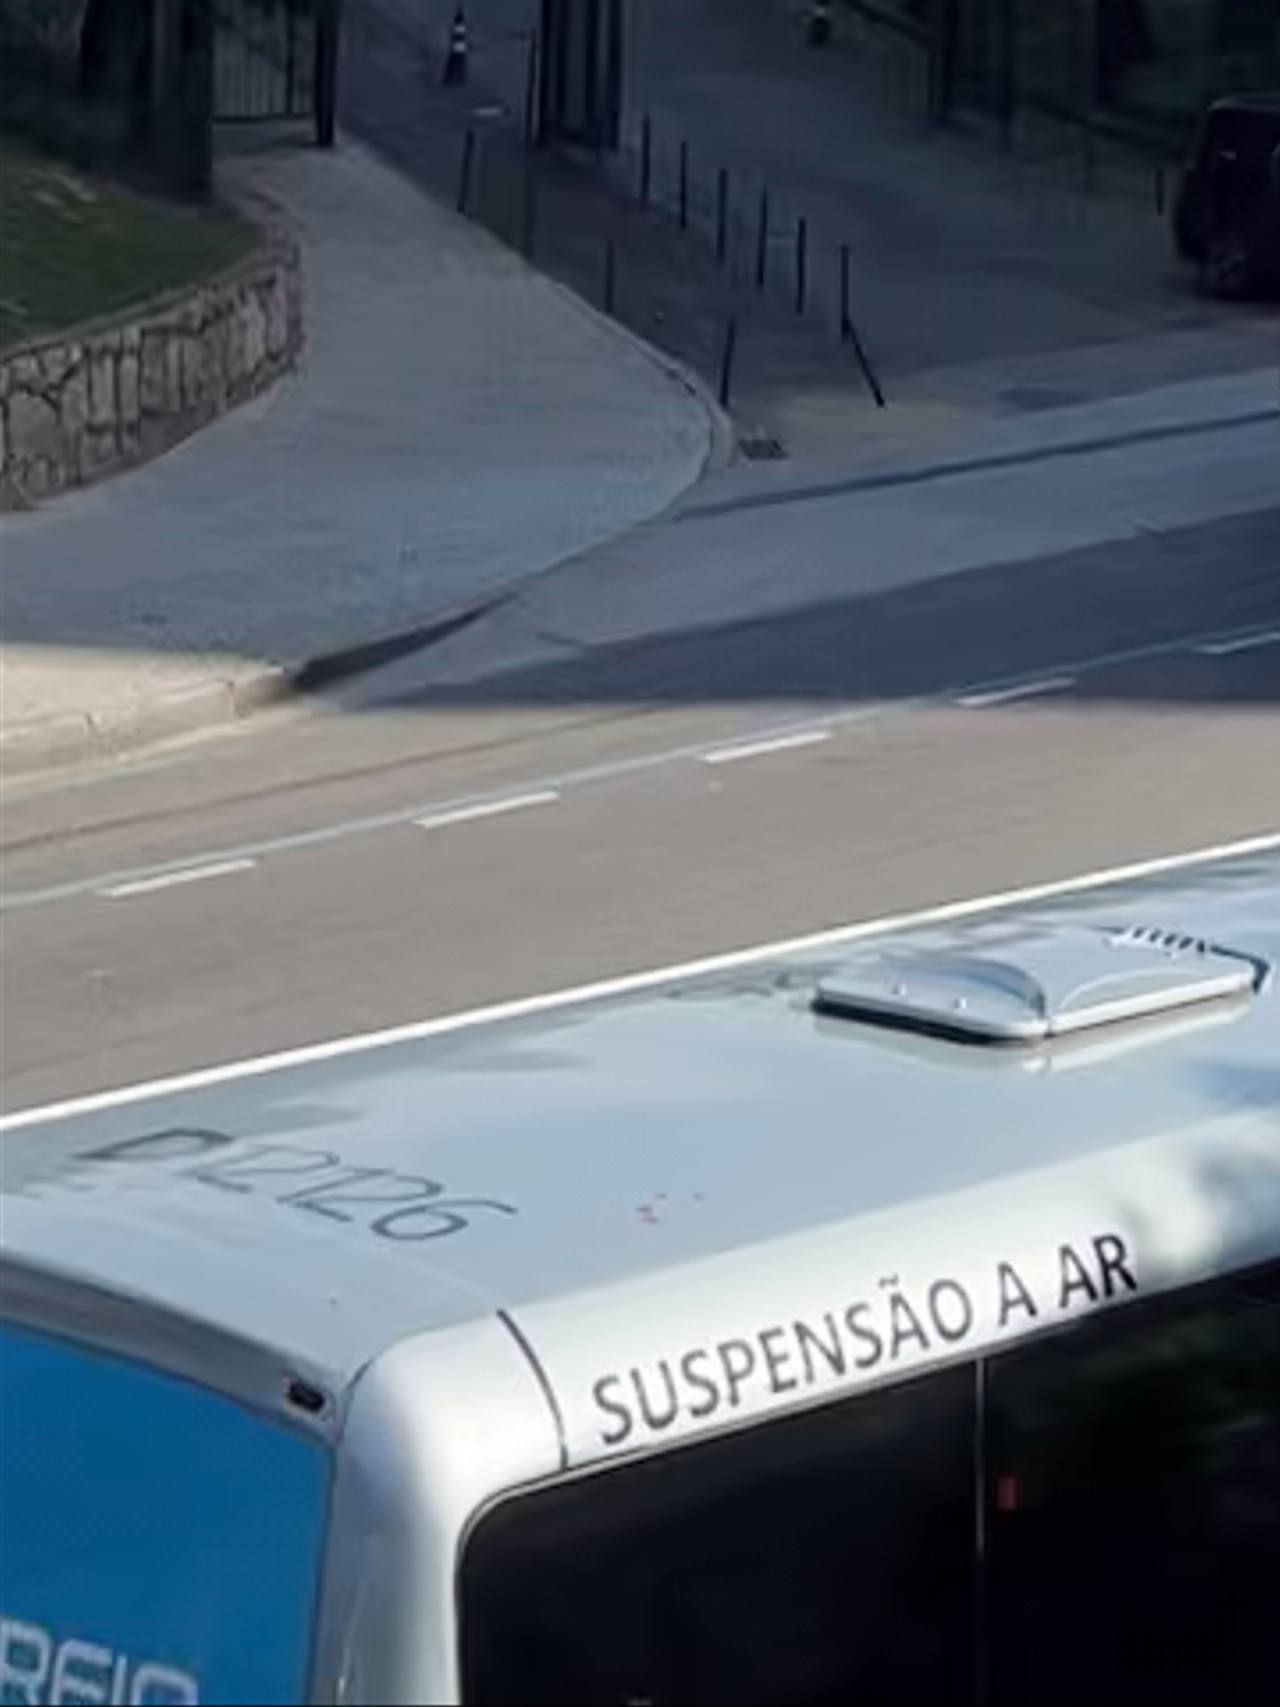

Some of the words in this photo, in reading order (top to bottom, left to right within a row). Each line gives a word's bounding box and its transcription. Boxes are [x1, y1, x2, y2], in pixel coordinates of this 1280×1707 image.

[591, 1272, 974, 1445] SUSPENSÃO
[997, 1260, 1037, 1326] A
[1058, 1233, 1138, 1309] AR
